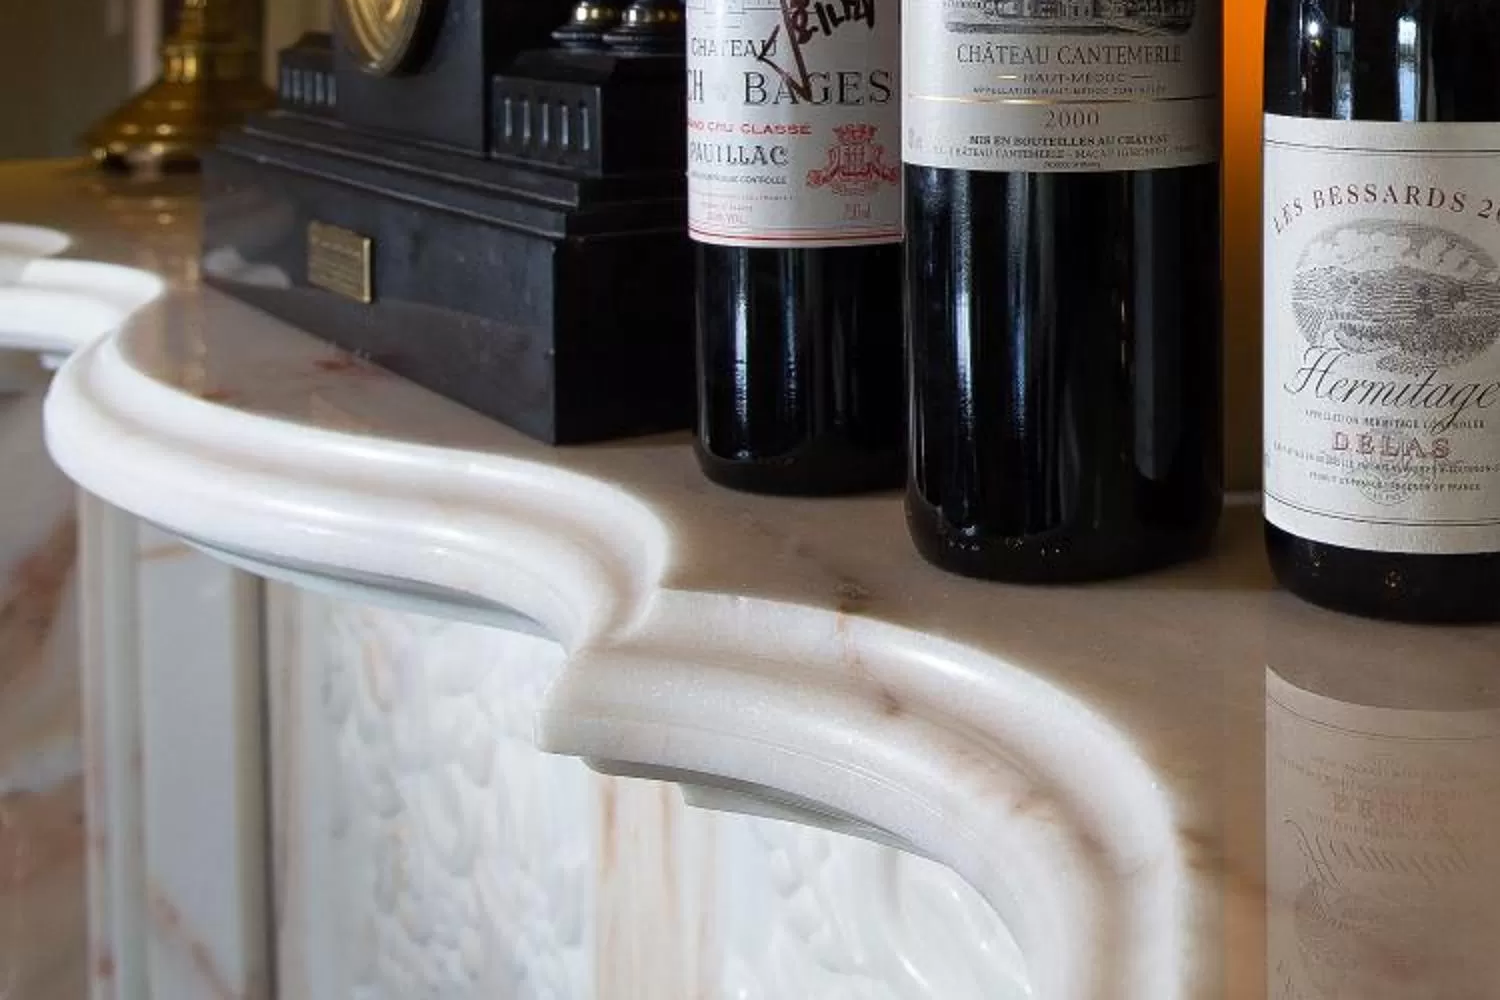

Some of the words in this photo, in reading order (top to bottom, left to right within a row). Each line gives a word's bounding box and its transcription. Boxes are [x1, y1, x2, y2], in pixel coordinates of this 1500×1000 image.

[956, 41, 1049, 66] CHÂTEAU
[743, 69, 892, 105] BAGES
[1044, 109, 1101, 130] 2000
[688, 138, 790, 167] PAUILLAC
[993, 135, 1010, 146] EN
[1272, 196, 1304, 236] LES
[1312, 182, 1467, 214] BESSARDS
[1330, 430, 1452, 461] DELAS
